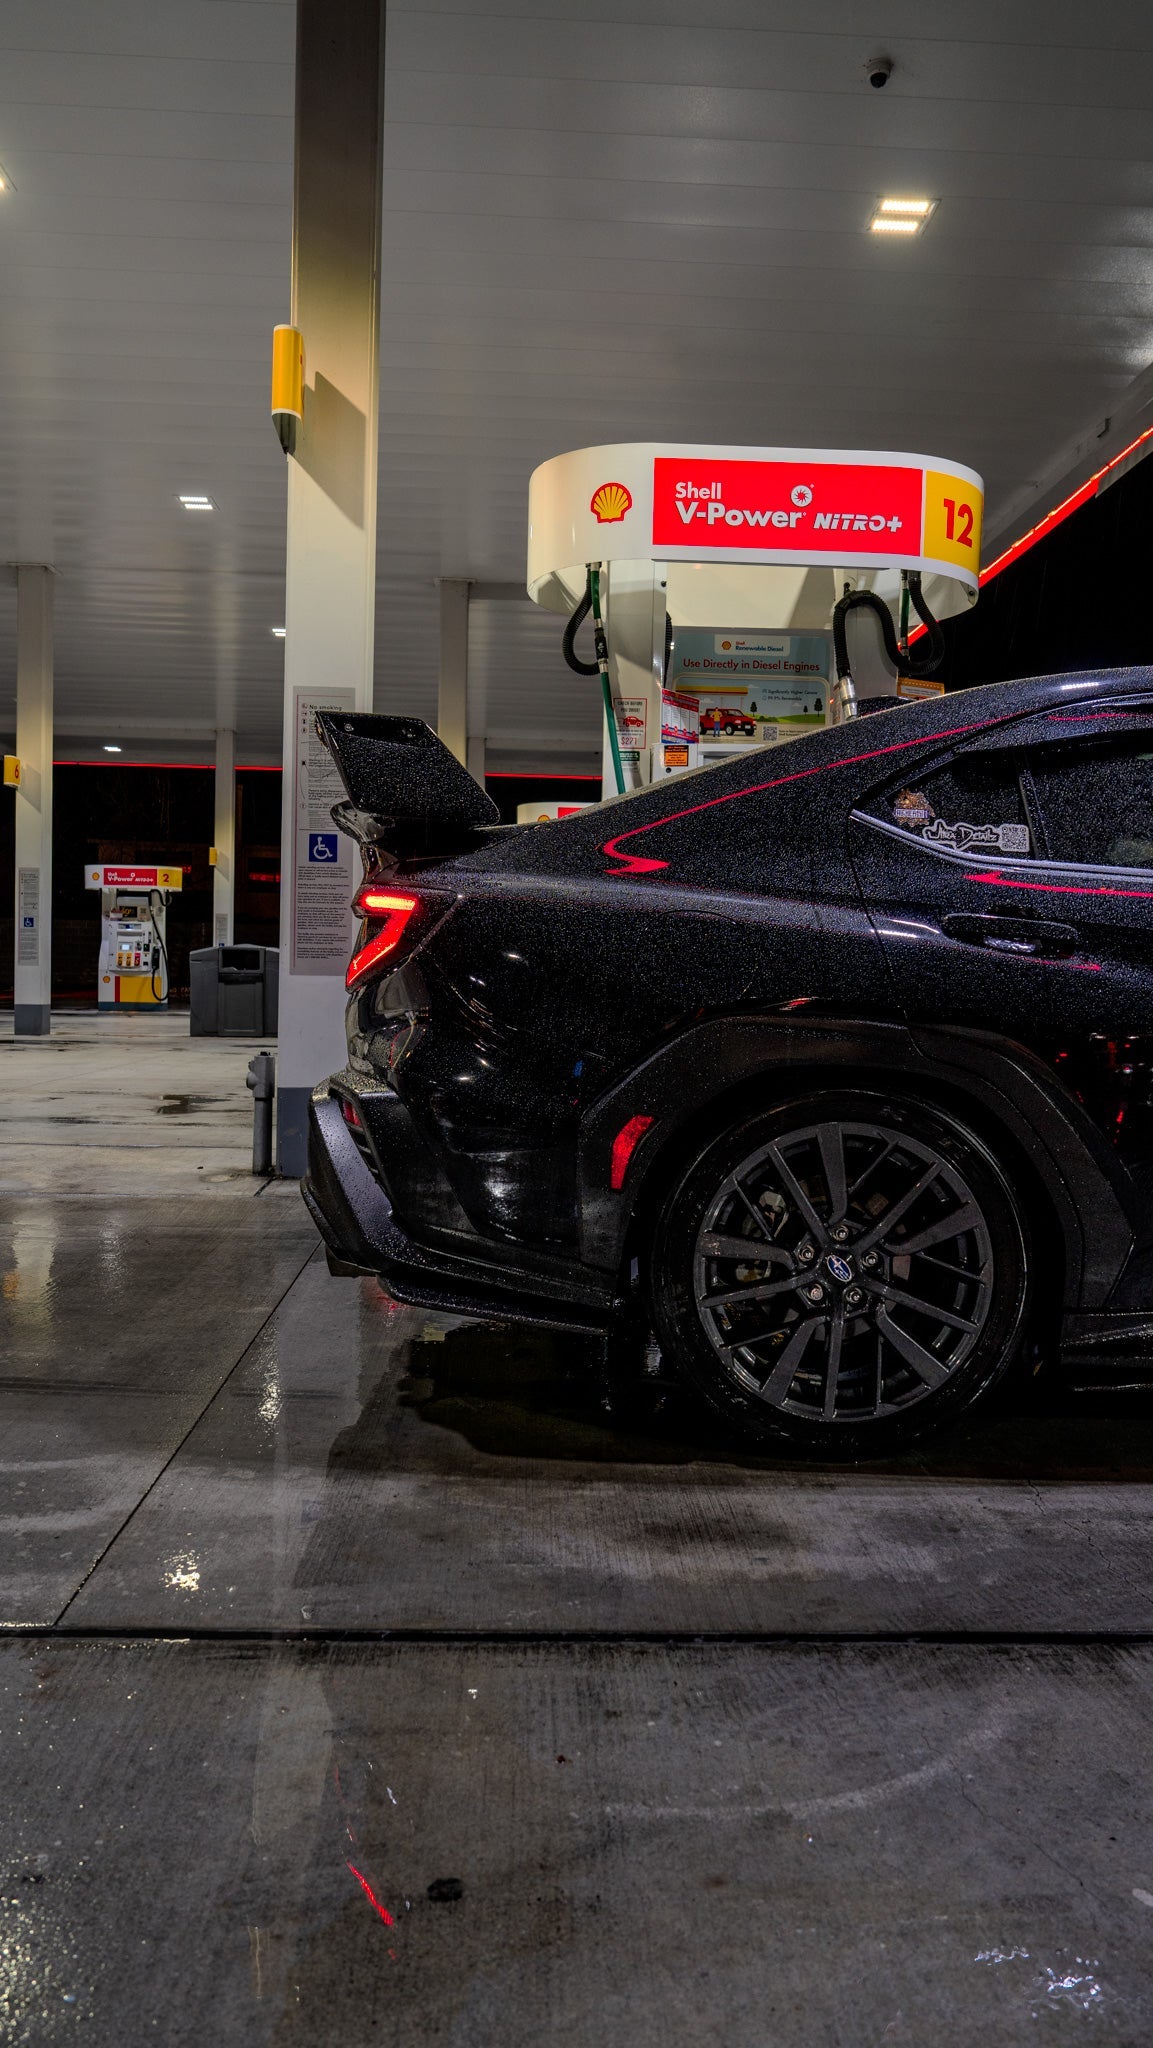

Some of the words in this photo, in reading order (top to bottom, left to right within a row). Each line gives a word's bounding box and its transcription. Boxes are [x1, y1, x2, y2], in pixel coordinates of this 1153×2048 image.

[675, 482, 722, 500] Shell
[675, 501, 802, 529] V-Power
[943, 497, 974, 548] 12
[683, 658, 701, 668] Use
[703, 659, 739, 671] Directly
[741, 659, 750, 669] in
[752, 659, 781, 670] Diesel
[783, 661, 821, 673] Engines
[14, 764, 19, 778] 6
[162, 873, 170, 883] 2
